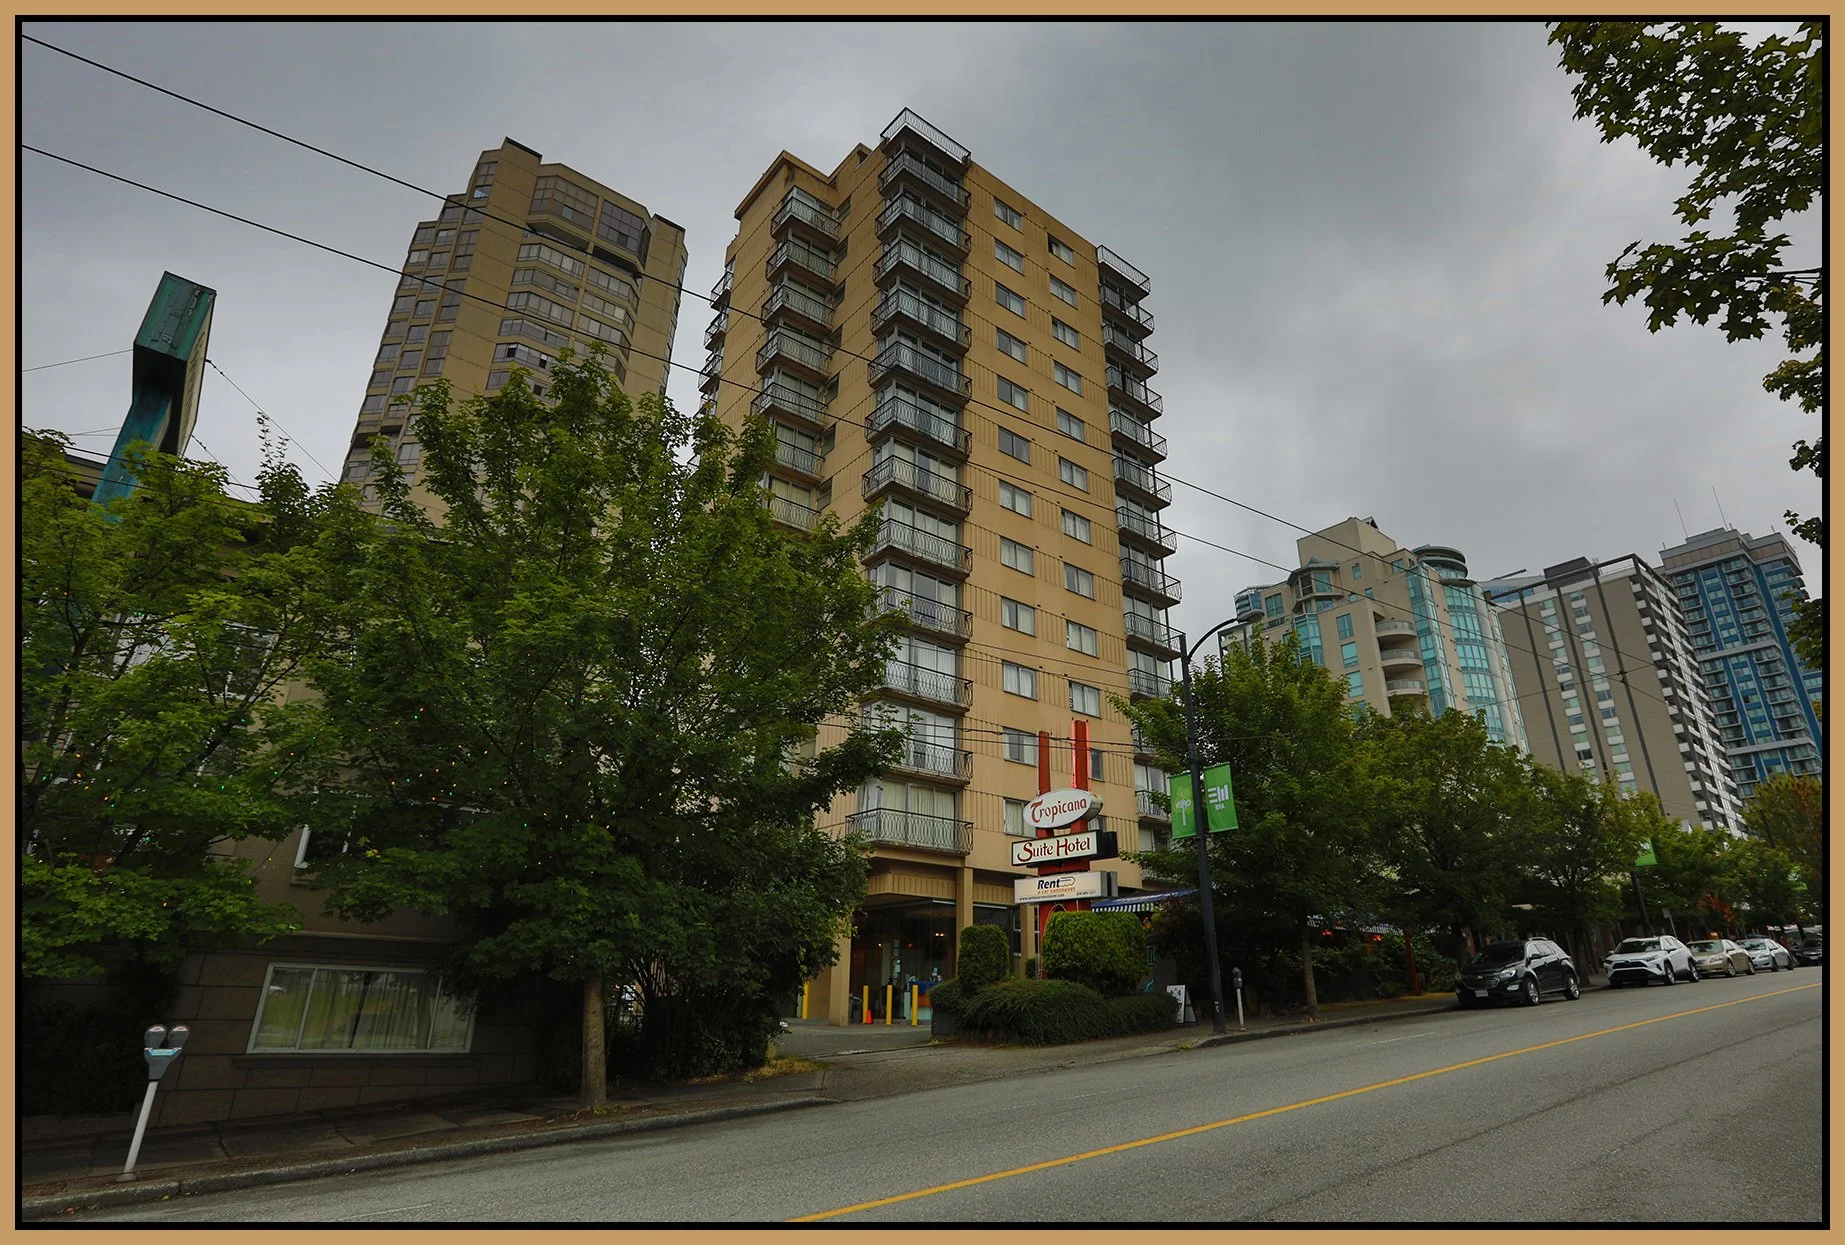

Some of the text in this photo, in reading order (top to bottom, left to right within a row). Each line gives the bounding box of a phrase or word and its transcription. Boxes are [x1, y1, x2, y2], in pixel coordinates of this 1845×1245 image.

[1030, 798, 1087, 823] Tropicana
[1017, 837, 1090, 862] Suite Hotel
[1038, 879, 1060, 890] Rent
